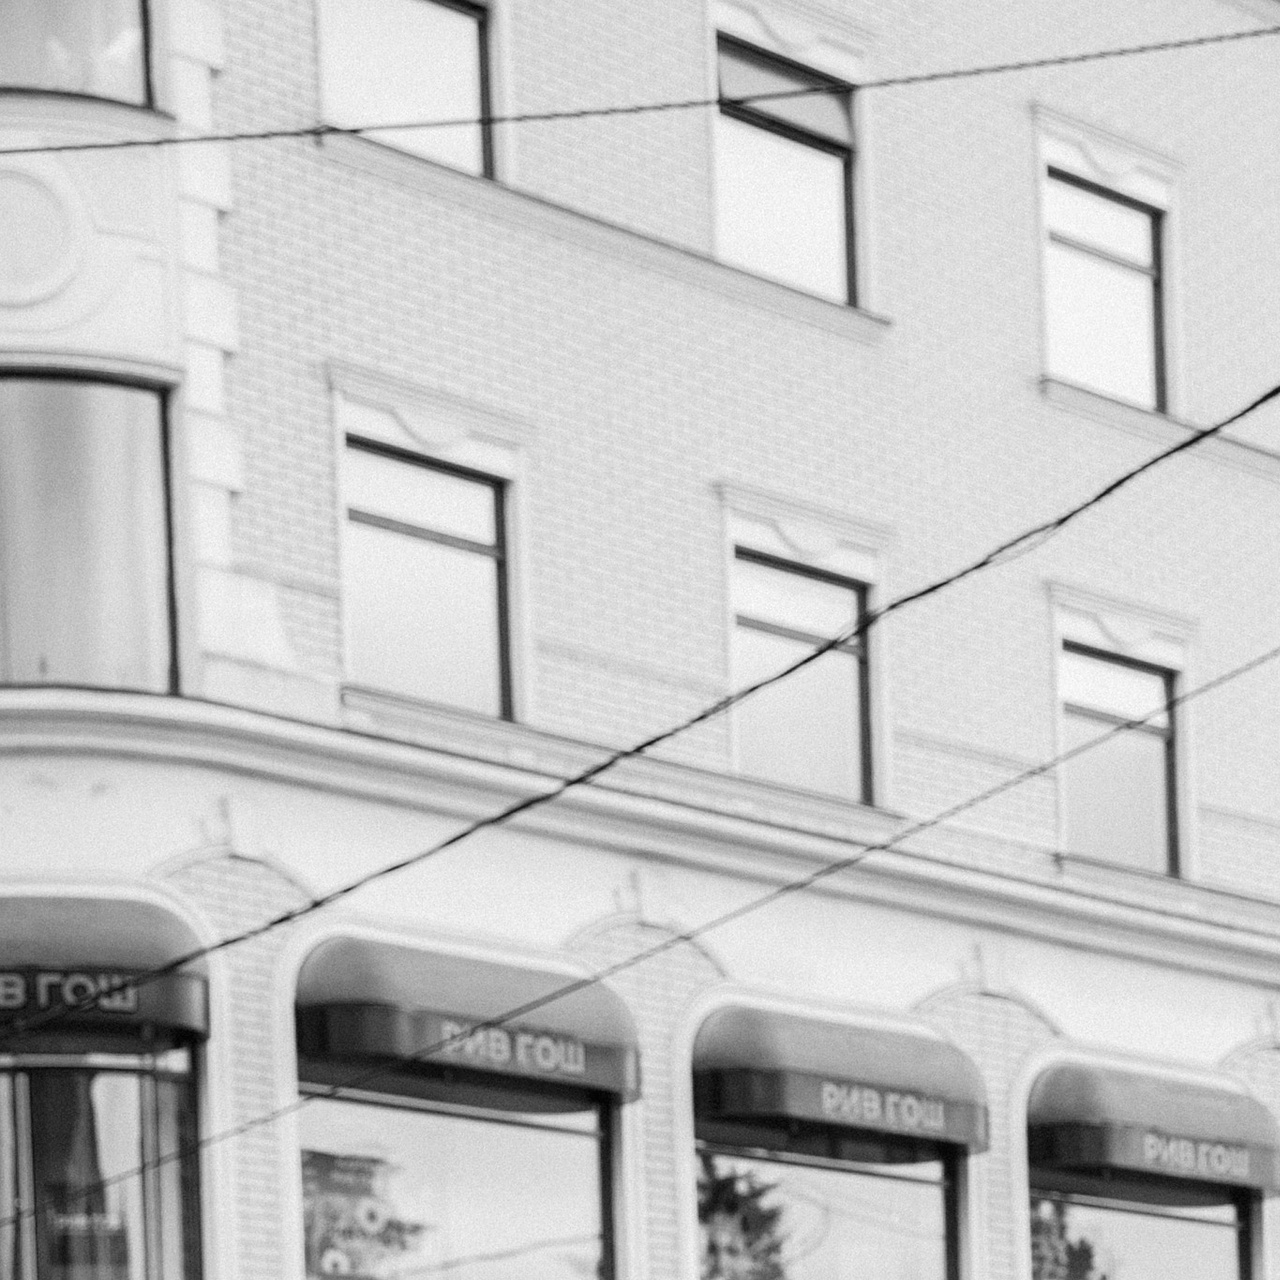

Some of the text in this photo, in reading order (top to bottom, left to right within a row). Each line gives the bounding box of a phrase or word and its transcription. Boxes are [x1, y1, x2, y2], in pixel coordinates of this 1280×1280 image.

[36, 972, 138, 1013] ГОШ
[515, 1031, 587, 1075] ГОШ
[821, 1080, 945, 1133] РИВ ГОШ
